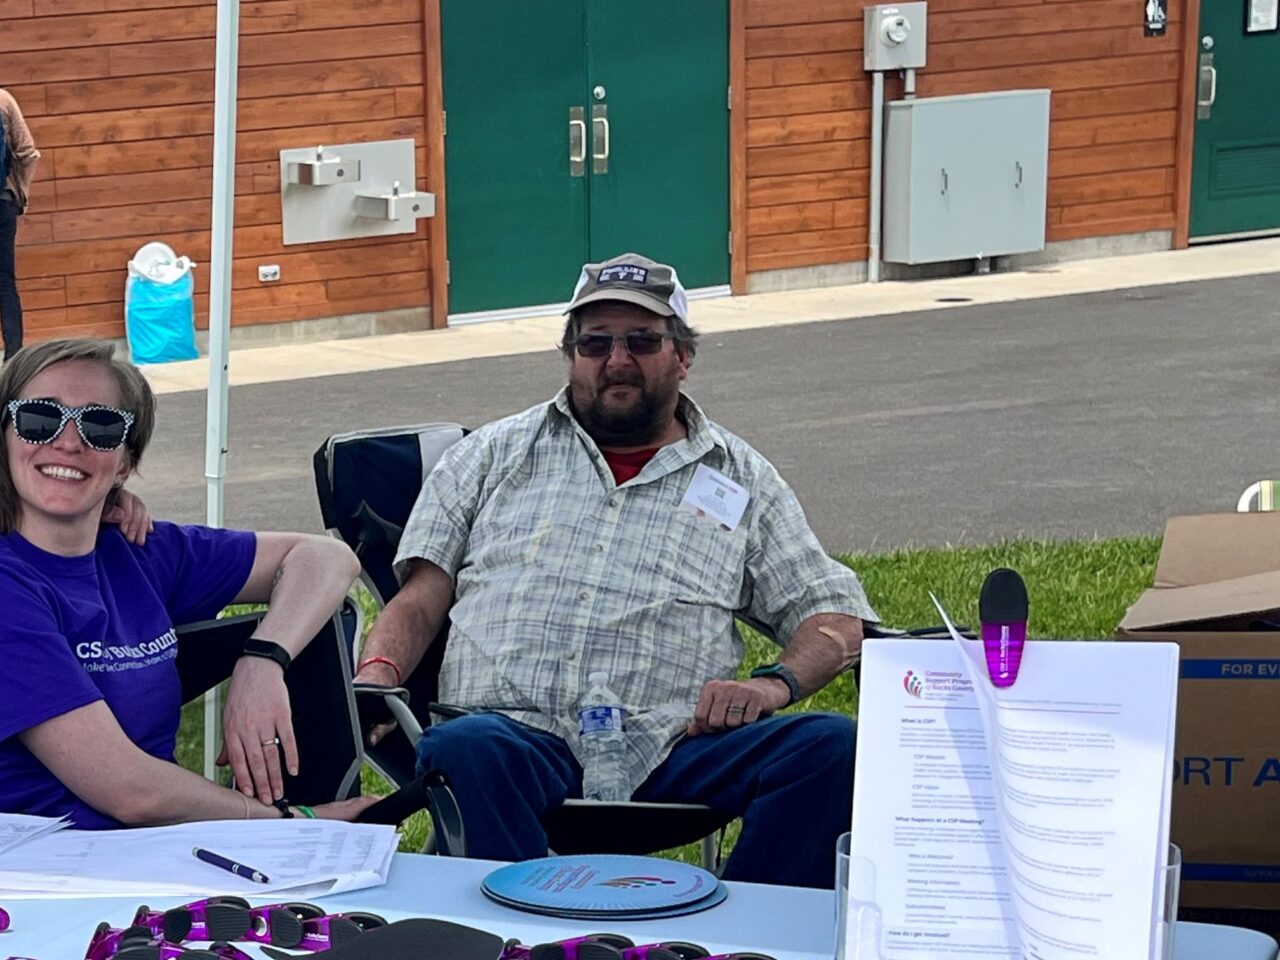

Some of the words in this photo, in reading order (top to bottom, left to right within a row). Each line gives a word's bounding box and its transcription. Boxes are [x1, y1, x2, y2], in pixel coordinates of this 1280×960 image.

[1222, 663, 1253, 675] FOR
[1258, 663, 1280, 675] EV
[1173, 757, 1244, 786] RT
